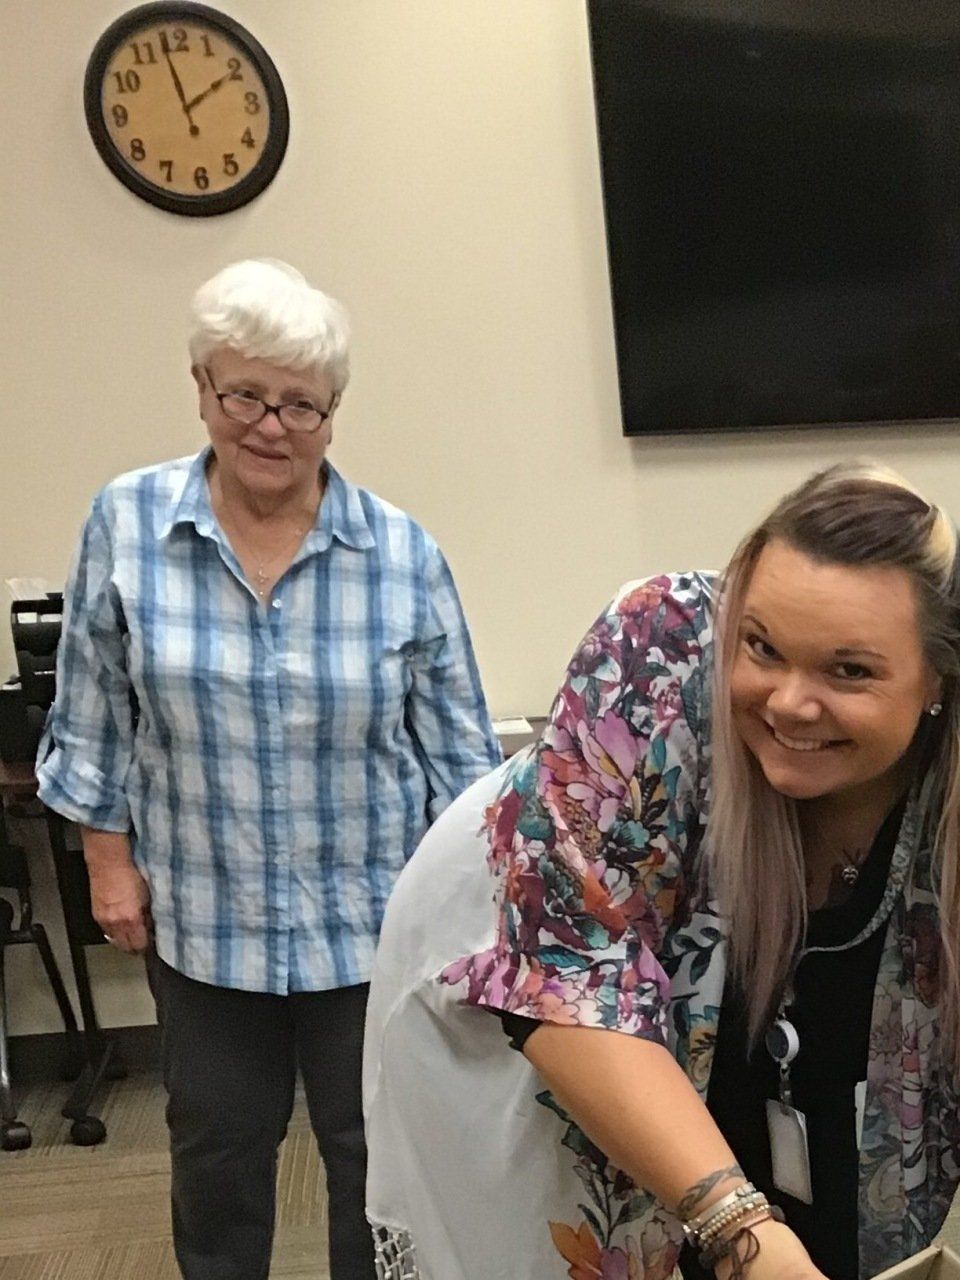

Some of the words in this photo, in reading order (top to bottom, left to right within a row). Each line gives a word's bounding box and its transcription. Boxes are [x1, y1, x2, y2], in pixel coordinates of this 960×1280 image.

[158, 28, 190, 53] 12
[200, 34, 215, 57] 1
[130, 41, 158, 65] 11
[227, 58, 243, 81] 2
[113, 69, 141, 94] 10
[244, 92, 260, 115] 3
[111, 104, 128, 128] 9
[130, 138, 146, 161] 8
[241, 127, 256, 149] 4
[159, 160, 173, 183] 7
[222, 153, 239, 176] 5
[194, 166, 209, 190] 6
